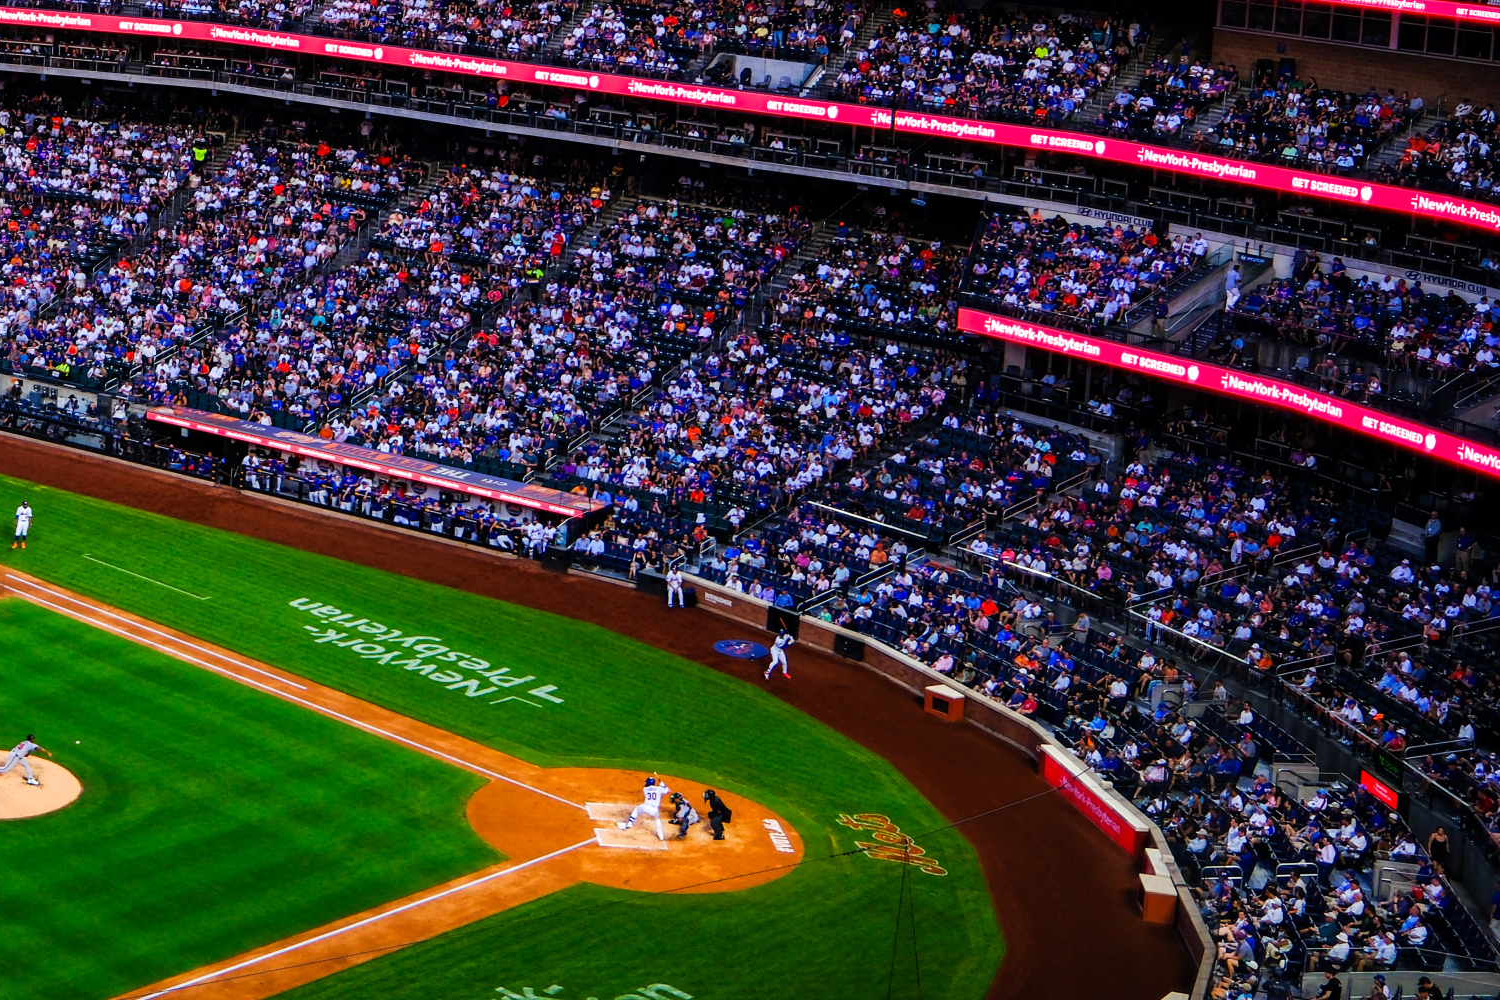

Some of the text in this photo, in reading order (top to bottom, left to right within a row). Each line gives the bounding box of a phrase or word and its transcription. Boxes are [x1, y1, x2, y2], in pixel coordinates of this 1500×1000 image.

[1469, 10, 1500, 19] SCREENED
[119, 22, 171, 33] GET SCREENED
[215, 26, 299, 47] NewYork-Presbyterian
[325, 44, 373, 57] GET SCREENED
[414, 52, 506, 74] NewYork-Presbyterian
[535, 71, 588, 85] GET SCREENED
[634, 80, 735, 104] NewYork-Presbyterian
[767, 101, 825, 115] GET SCREENED
[1031, 134, 1093, 150] GET SCREENED
[1144, 150, 1255, 179] NewYork-Presbyterian
[1292, 177, 1358, 197] GET SCREENED
[1094, 211, 1153, 228] HYUNDAI CLUB
[1423, 273, 1487, 294] HYUNDAI CLUB
[991, 318, 1100, 355] NewYork-Presbyterian
[1121, 353, 1185, 375] GET SCREENED
[1229, 376, 1342, 417] NewYork-Presbyterian
[1362, 416, 1423, 443] GET SCREENED
[431, 466, 471, 480] THE
[646, 792, 657, 800] 30
